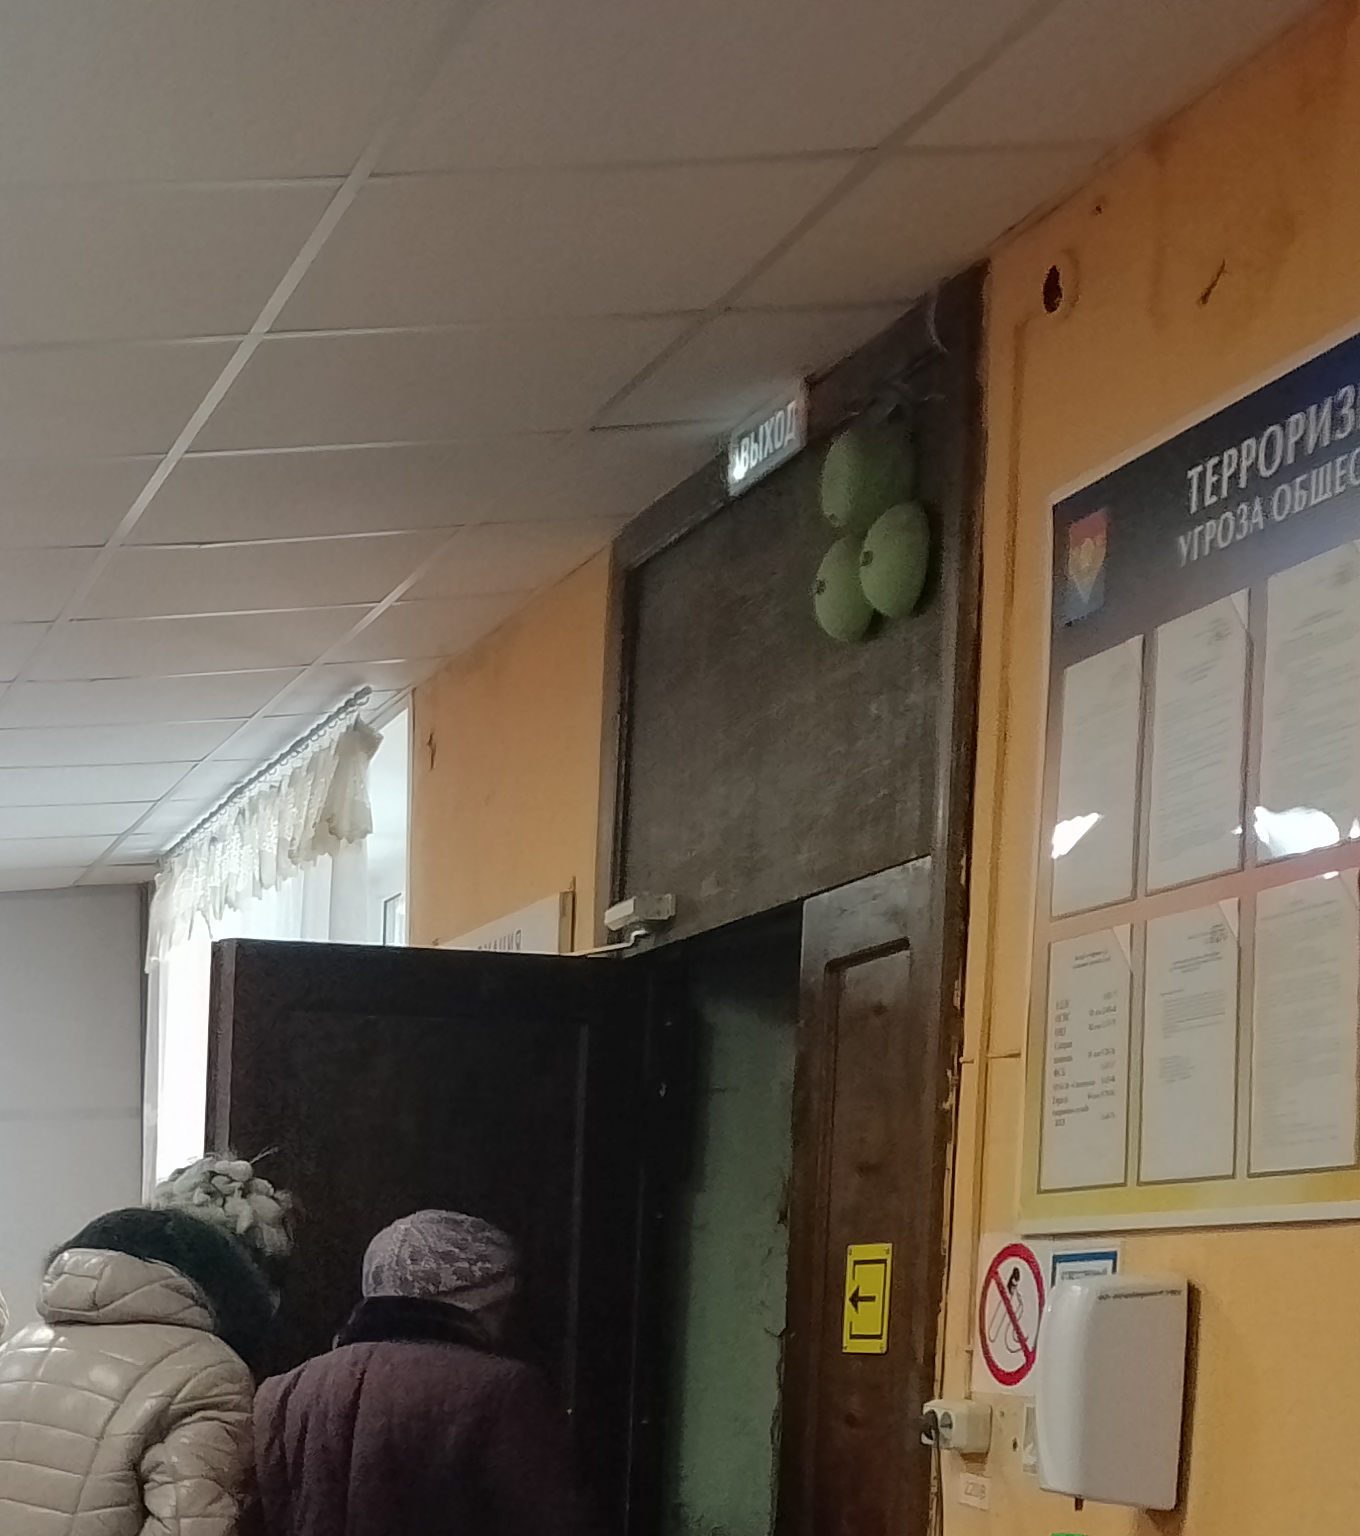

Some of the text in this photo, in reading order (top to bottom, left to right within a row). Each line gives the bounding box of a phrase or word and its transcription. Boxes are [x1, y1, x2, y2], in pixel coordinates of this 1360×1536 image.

[740, 400, 798, 470] ВЫХОД
[1186, 380, 1360, 515] ТЕРРОРИЗ
[1176, 495, 1264, 568] УГРОЗА
